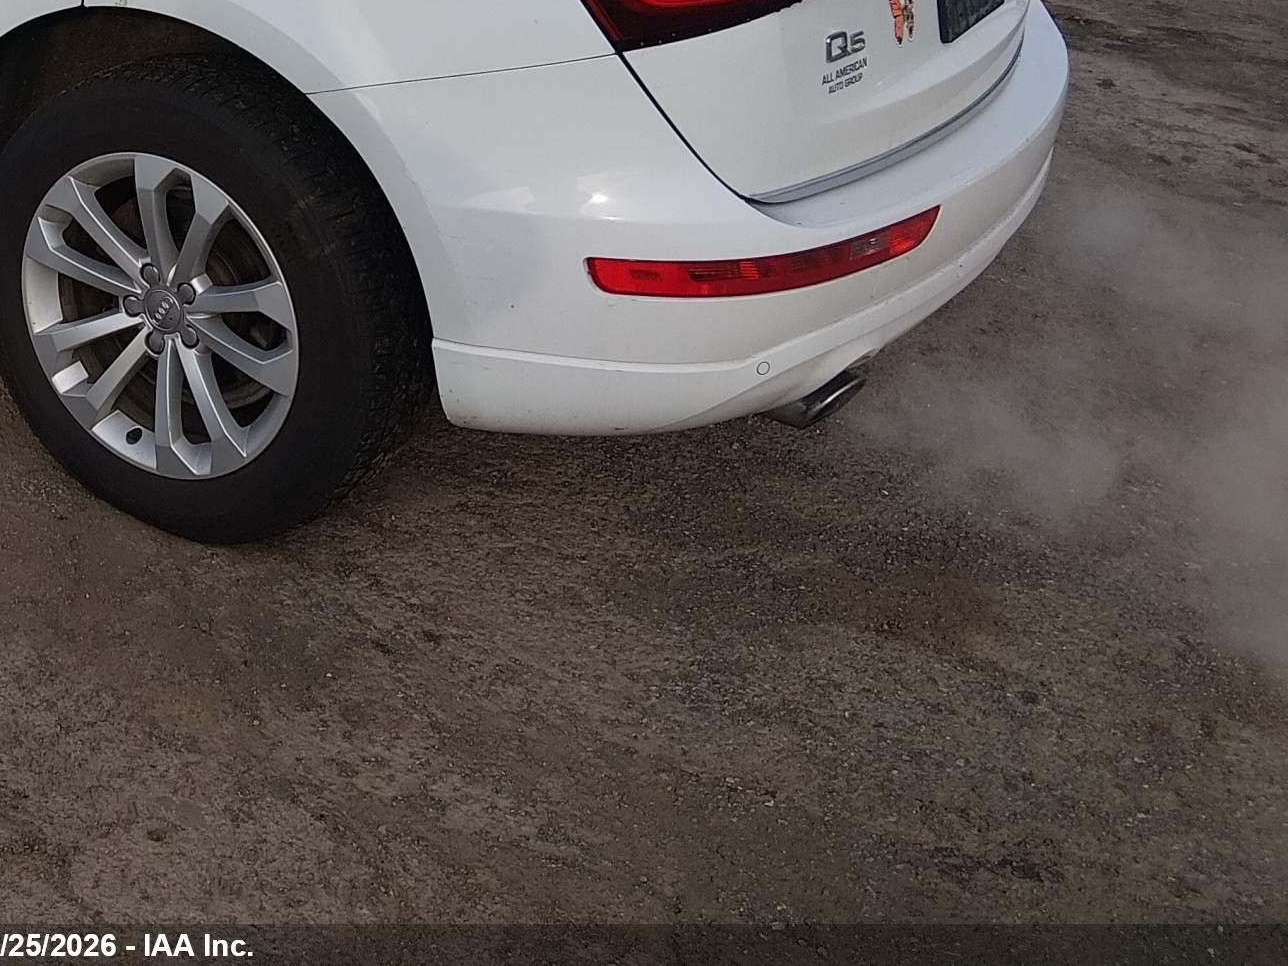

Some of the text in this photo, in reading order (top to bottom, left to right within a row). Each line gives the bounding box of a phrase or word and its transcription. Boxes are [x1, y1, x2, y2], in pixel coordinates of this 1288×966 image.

[825, 30, 866, 64] Q5
[821, 57, 868, 86] ALL AMERICAN
[828, 72, 863, 94] AUTO GROUP
